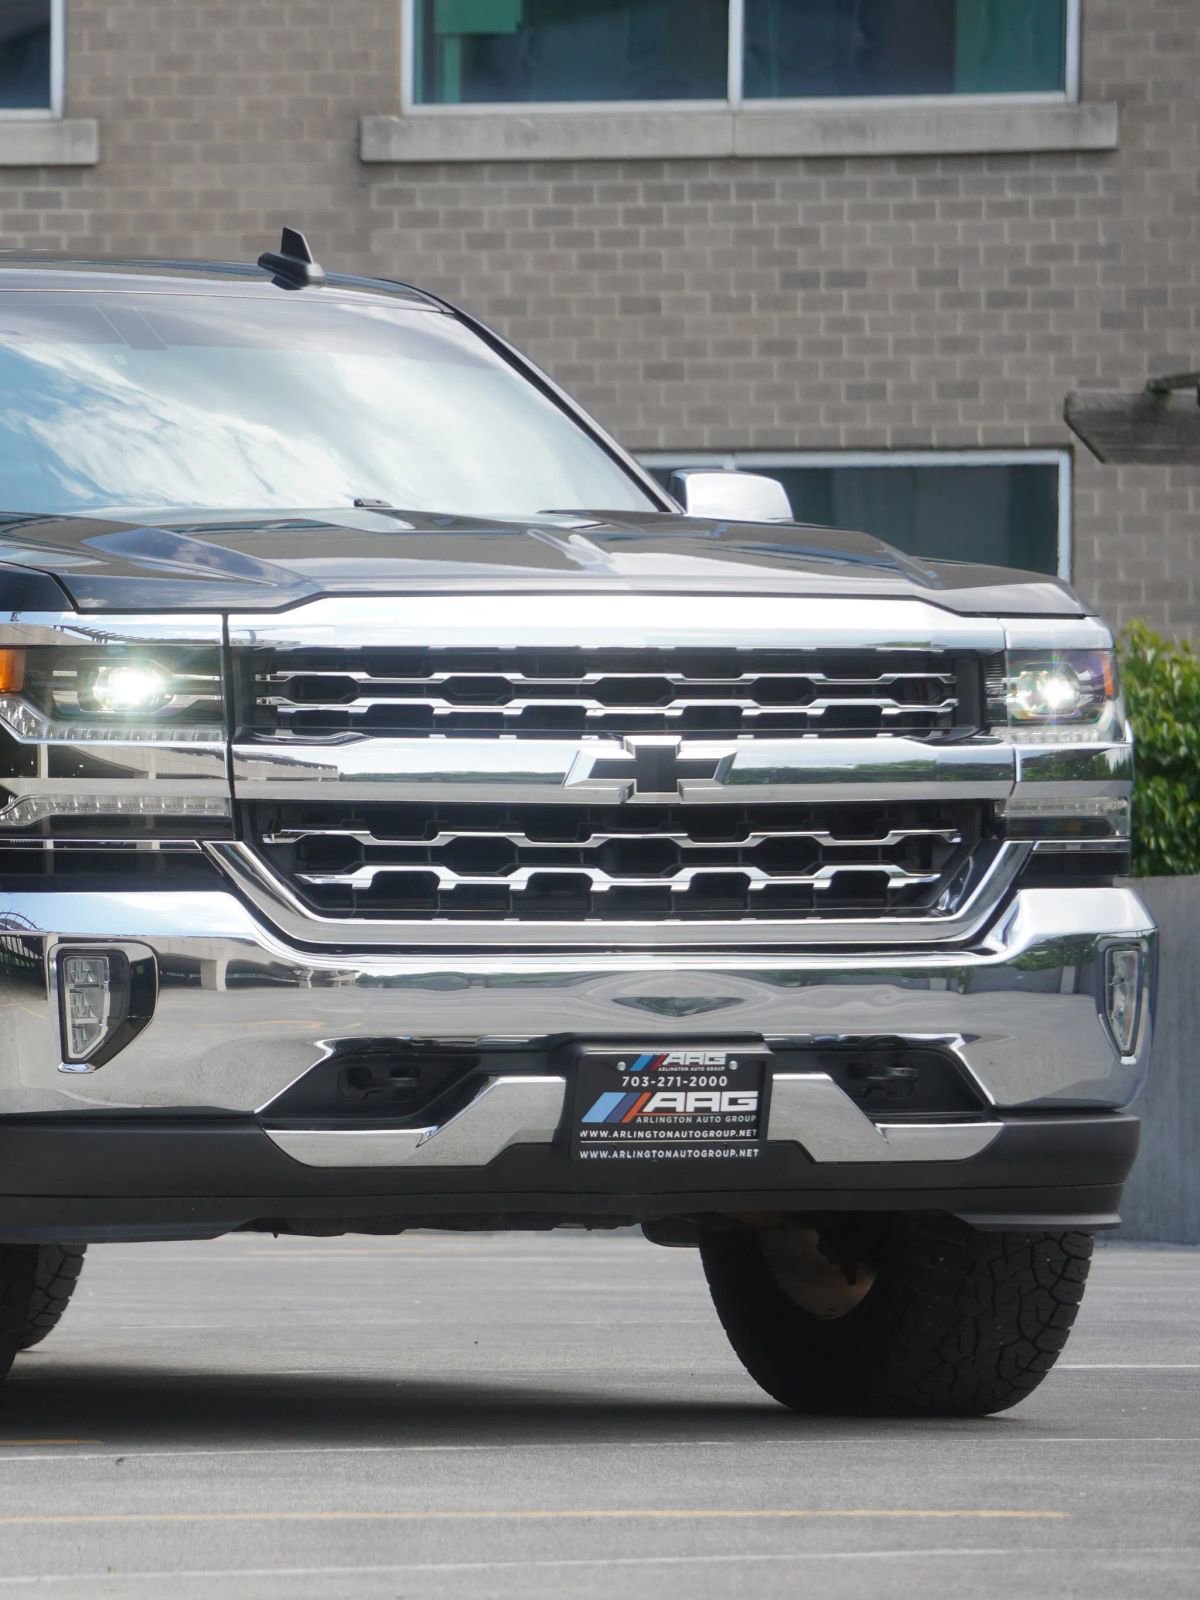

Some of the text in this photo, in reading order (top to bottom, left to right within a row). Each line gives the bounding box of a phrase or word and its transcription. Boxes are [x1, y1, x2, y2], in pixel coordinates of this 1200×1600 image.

[661, 1053, 727, 1066] AAG
[621, 1075, 728, 1087] 703-271-2000
[642, 1090, 759, 1113] AAG
[636, 1116, 692, 1124] ARLINGTON
[725, 1115, 757, 1123] GROUP
[579, 1129, 757, 1139] WWW.ARLINGTONAUTOGROUP.NET
[579, 1149, 760, 1159] WWW.ARLINGTONAUTOGROUP.NET
